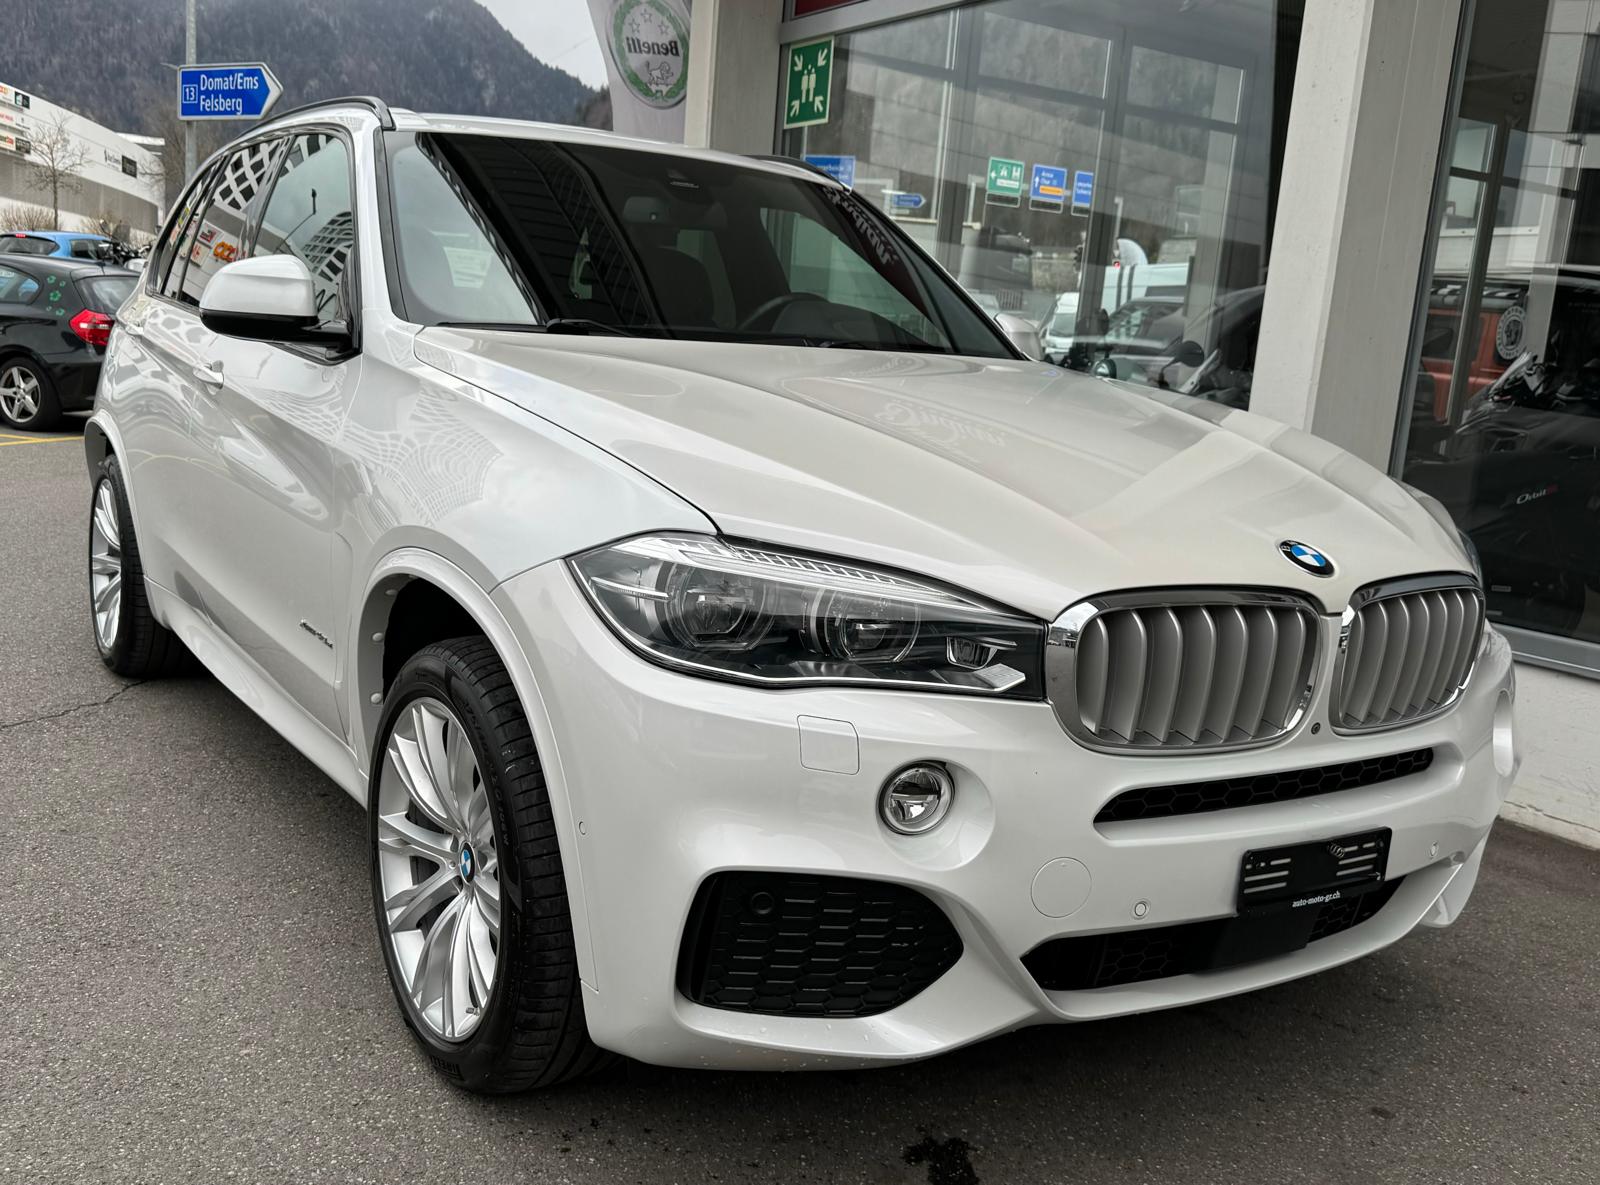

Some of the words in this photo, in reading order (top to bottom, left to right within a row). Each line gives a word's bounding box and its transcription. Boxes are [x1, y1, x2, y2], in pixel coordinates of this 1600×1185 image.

[200, 73, 259, 91] Domat/Ems
[185, 87, 195, 101] 13
[200, 94, 243, 115] Felsberg
[1292, 890, 1341, 907] auto-moto-gr.ch
